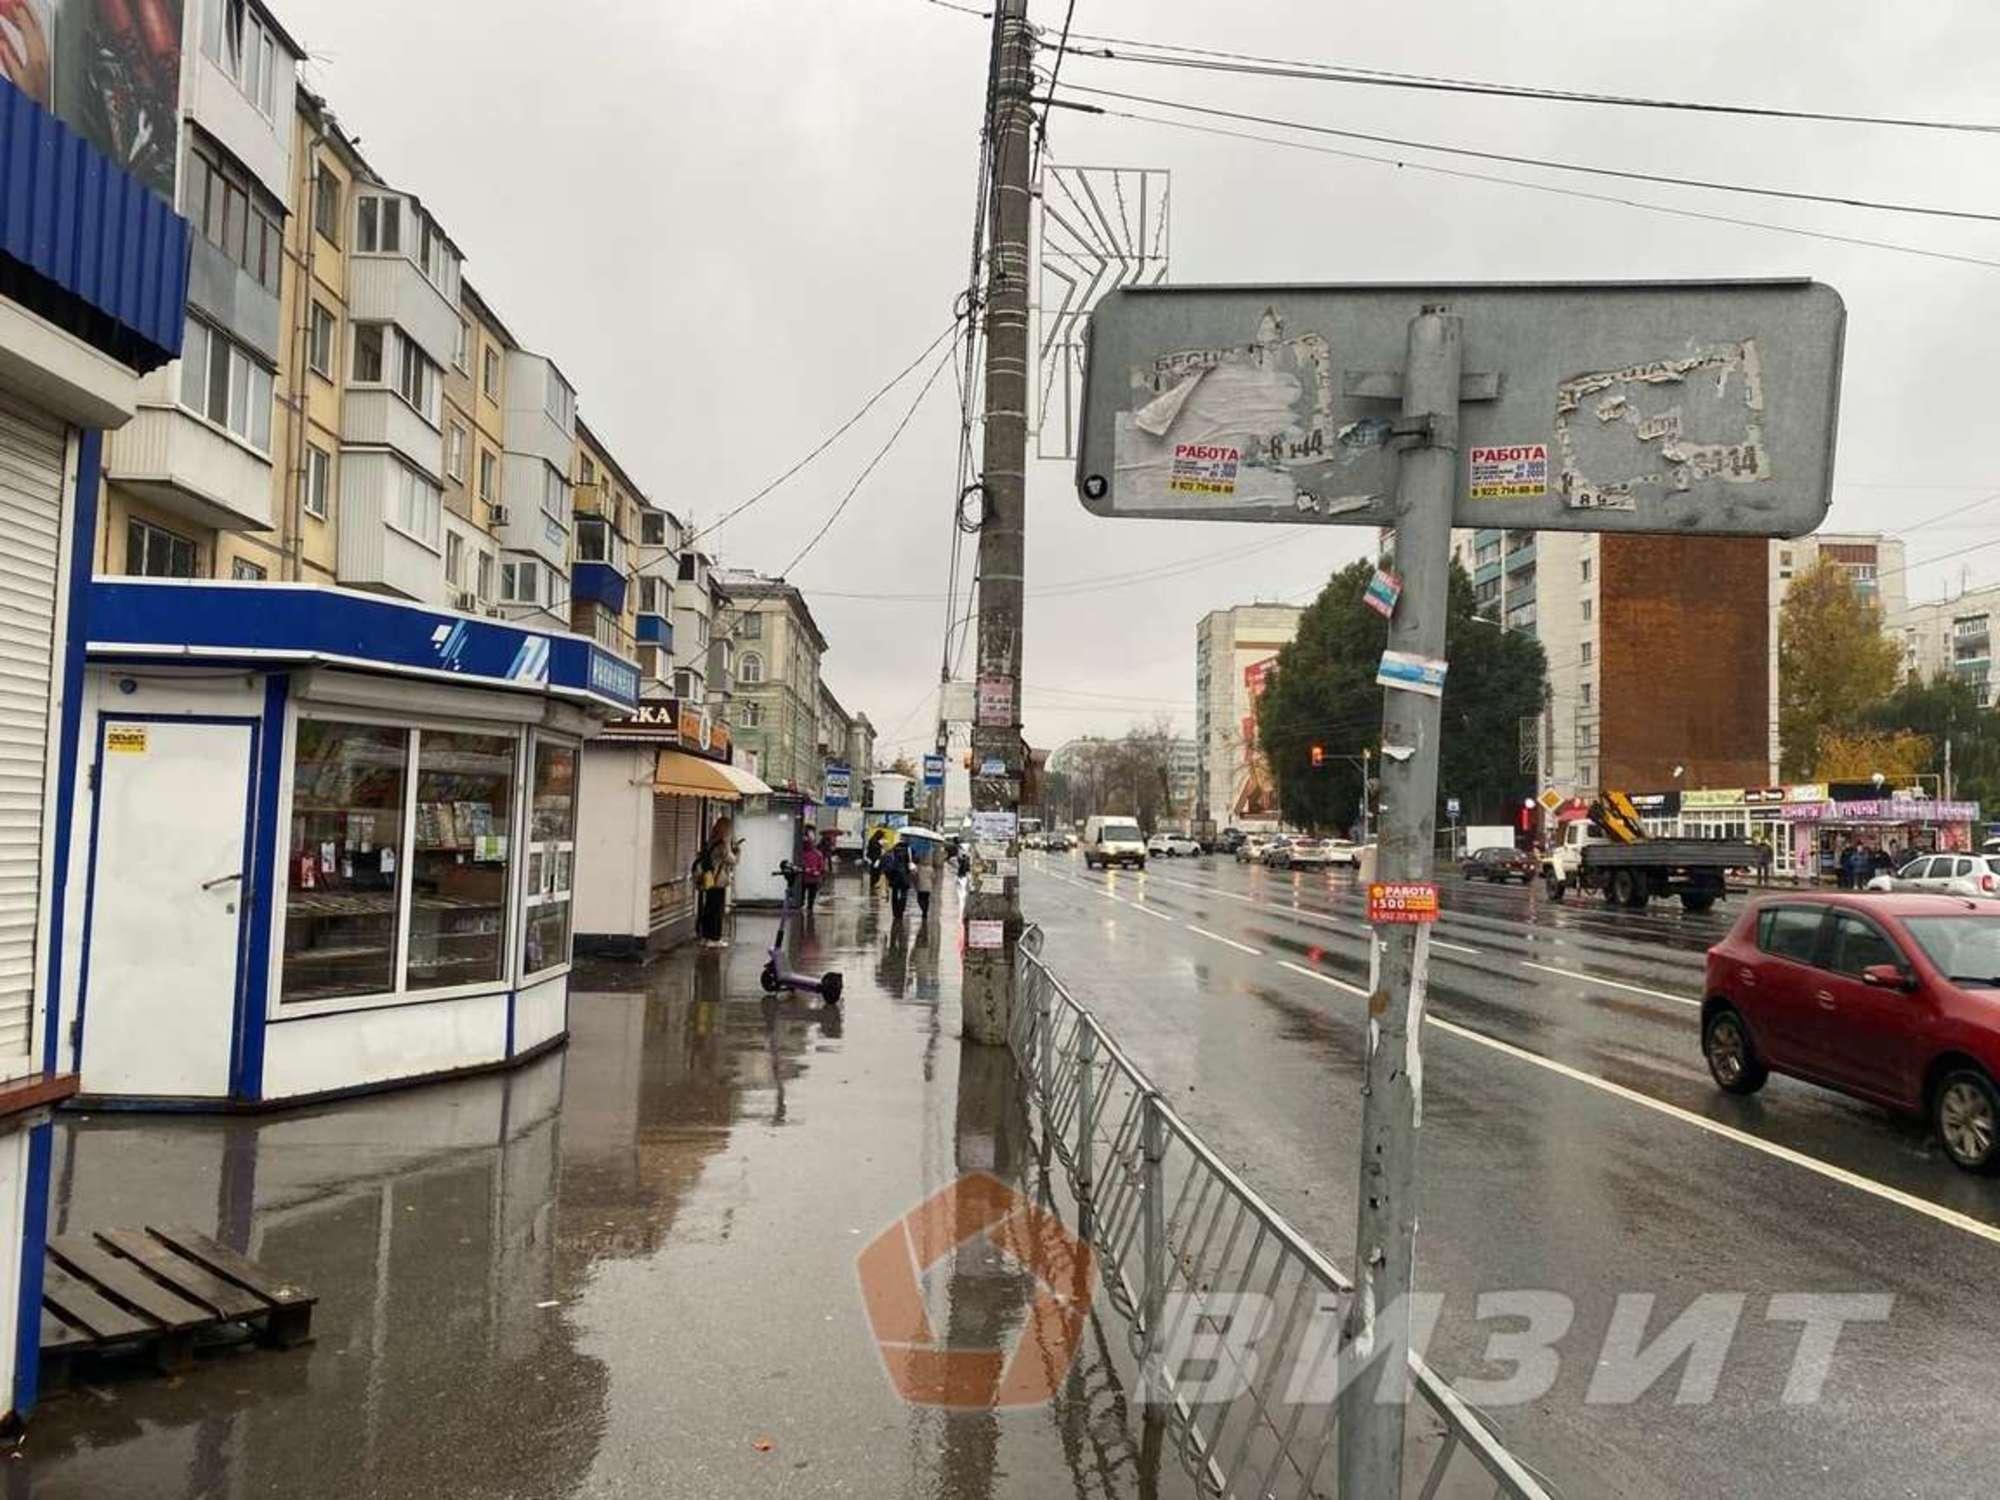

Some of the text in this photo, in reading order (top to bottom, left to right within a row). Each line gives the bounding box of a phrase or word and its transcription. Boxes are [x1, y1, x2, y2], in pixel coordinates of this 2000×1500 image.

[1174, 444, 1239, 461] РАБОТА
[1472, 446, 1546, 462] РАБОТА
[1384, 886, 1434, 898] РАБОТА
[1372, 898, 1406, 910] 1500
